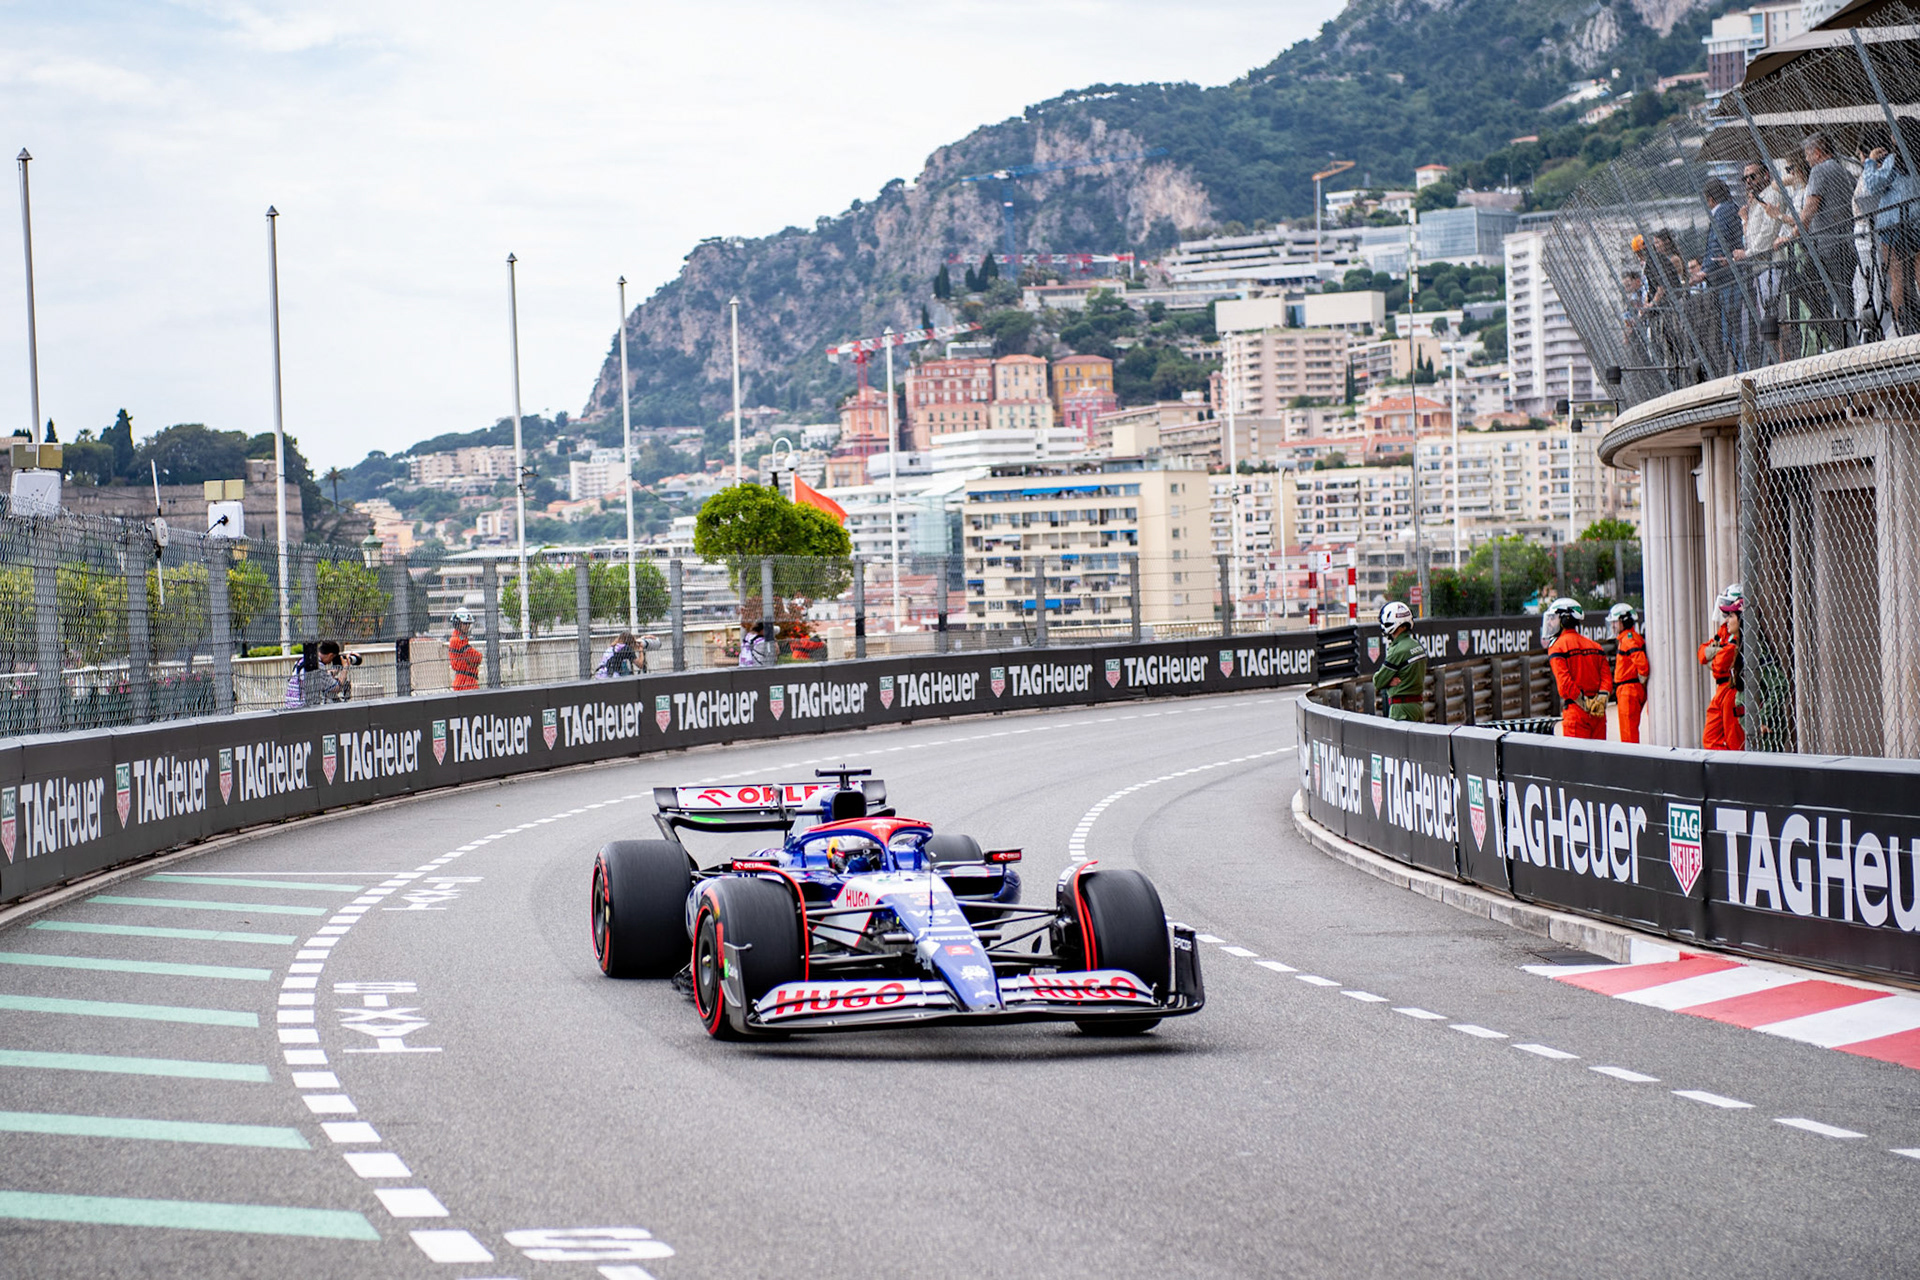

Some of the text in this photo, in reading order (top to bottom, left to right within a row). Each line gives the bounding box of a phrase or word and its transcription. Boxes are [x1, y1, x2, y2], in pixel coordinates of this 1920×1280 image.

[1471, 627, 1532, 654] TAGHeuer
[1124, 654, 1209, 687] TAGHeuer
[1236, 647, 1315, 677] TAGHeuer
[897, 671, 980, 707] TAGHeuer
[1008, 663, 1093, 696] TAGHeuer
[674, 690, 758, 730] TAGHeuer
[787, 681, 868, 719] TAGHeuer
[433, 722, 445, 738] TAG
[543, 710, 556, 725] TAG
[560, 701, 643, 747] TAGHeuer
[323, 738, 336, 754] TAG
[340, 728, 422, 782] TAGHeuer
[450, 714, 531, 763] TAGHeuer
[219, 751, 231, 771] TAG
[235, 741, 311, 801] TAGHeuer
[117, 767, 129, 789] TAG
[134, 756, 209, 824] TAGHeuer
[1384, 756, 1461, 843] TAGHeuer
[20, 777, 104, 858] TAGHeuer
[1486, 778, 1647, 884] TAGHeuer
[1671, 810, 1699, 839] TAG
[1671, 844, 1700, 888] HEUER
[845, 888, 870, 907] HUGO
[775, 982, 906, 1015] HUGO
[1028, 976, 1139, 999] HUGO
